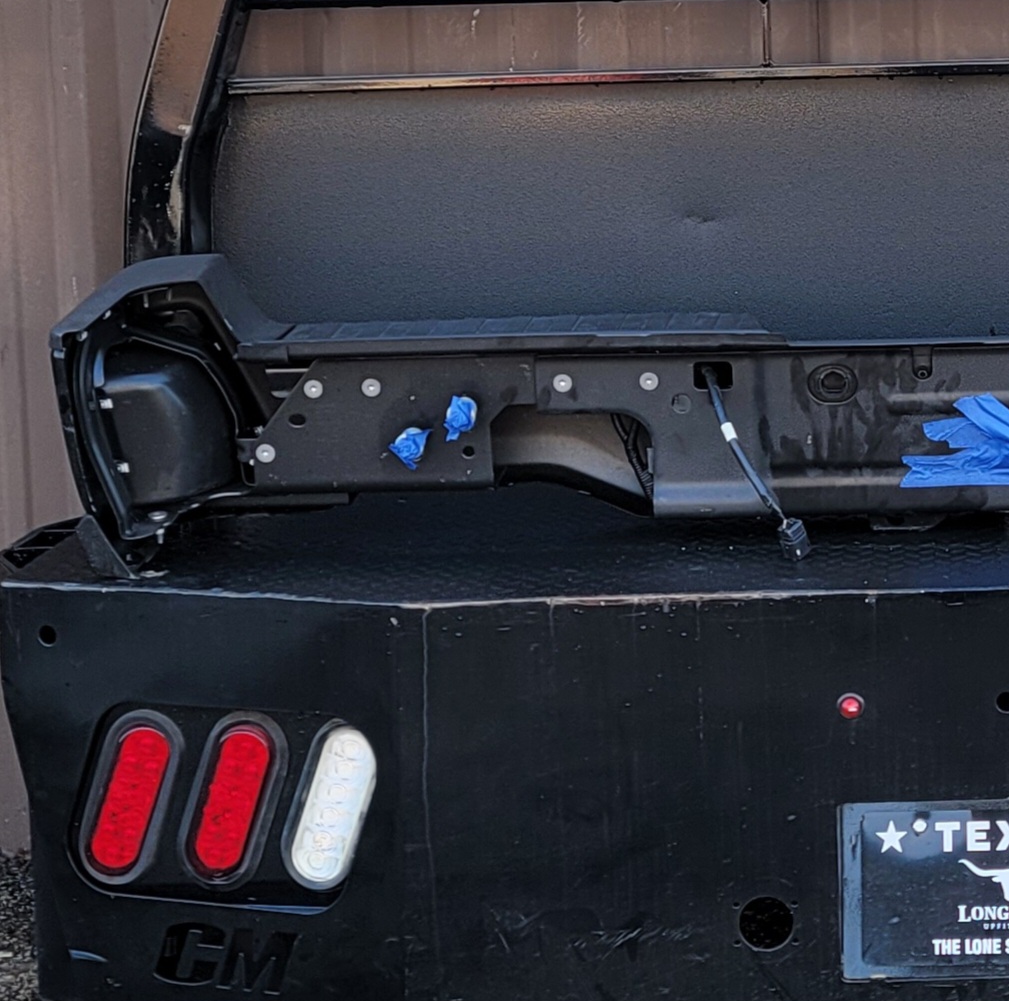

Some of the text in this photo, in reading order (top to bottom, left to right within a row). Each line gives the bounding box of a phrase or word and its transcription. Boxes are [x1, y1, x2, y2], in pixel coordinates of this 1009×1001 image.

[153, 921, 302, 996] CM
[932, 938, 961, 956] THE
[964, 938, 1002, 955] LONE
